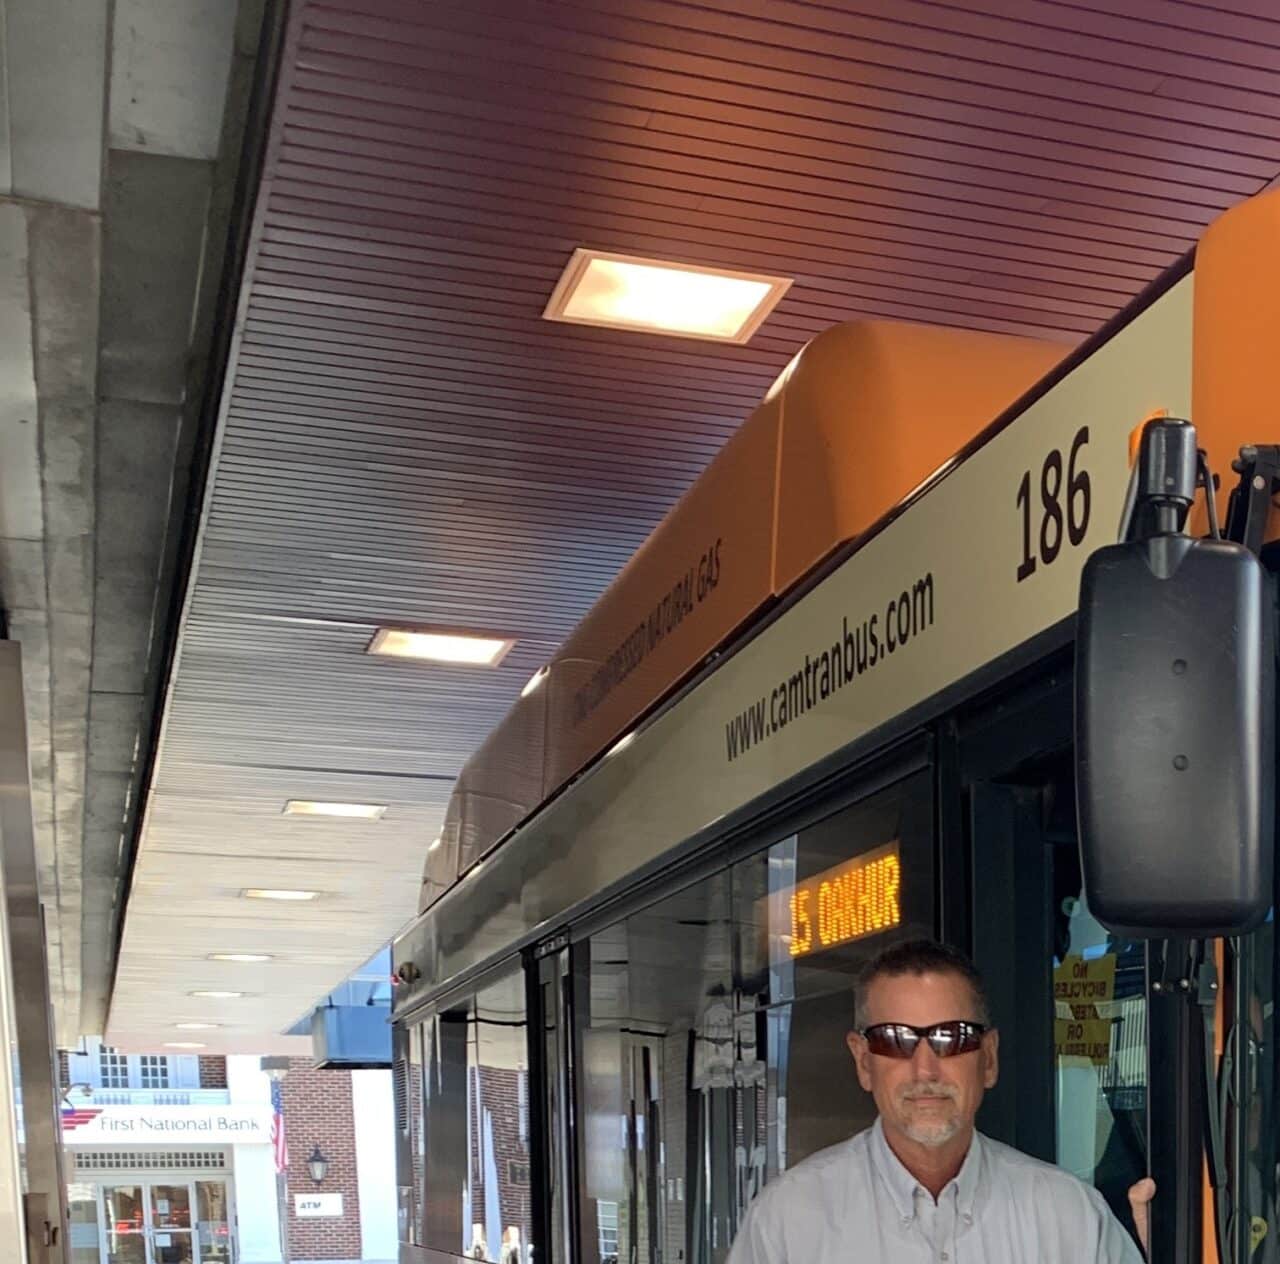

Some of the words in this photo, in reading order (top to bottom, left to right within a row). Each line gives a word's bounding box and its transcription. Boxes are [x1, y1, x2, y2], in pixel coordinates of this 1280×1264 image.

[1016, 425, 1091, 584] 186
[647, 567, 694, 653] NATURAL
[697, 537, 722, 603] GAS
[725, 572, 934, 762] www.camtranbus.com
[100, 1116, 135, 1131] First
[140, 1116, 212, 1131] National
[217, 1116, 260, 1131] Bank
[299, 1200, 321, 1209] ATM
